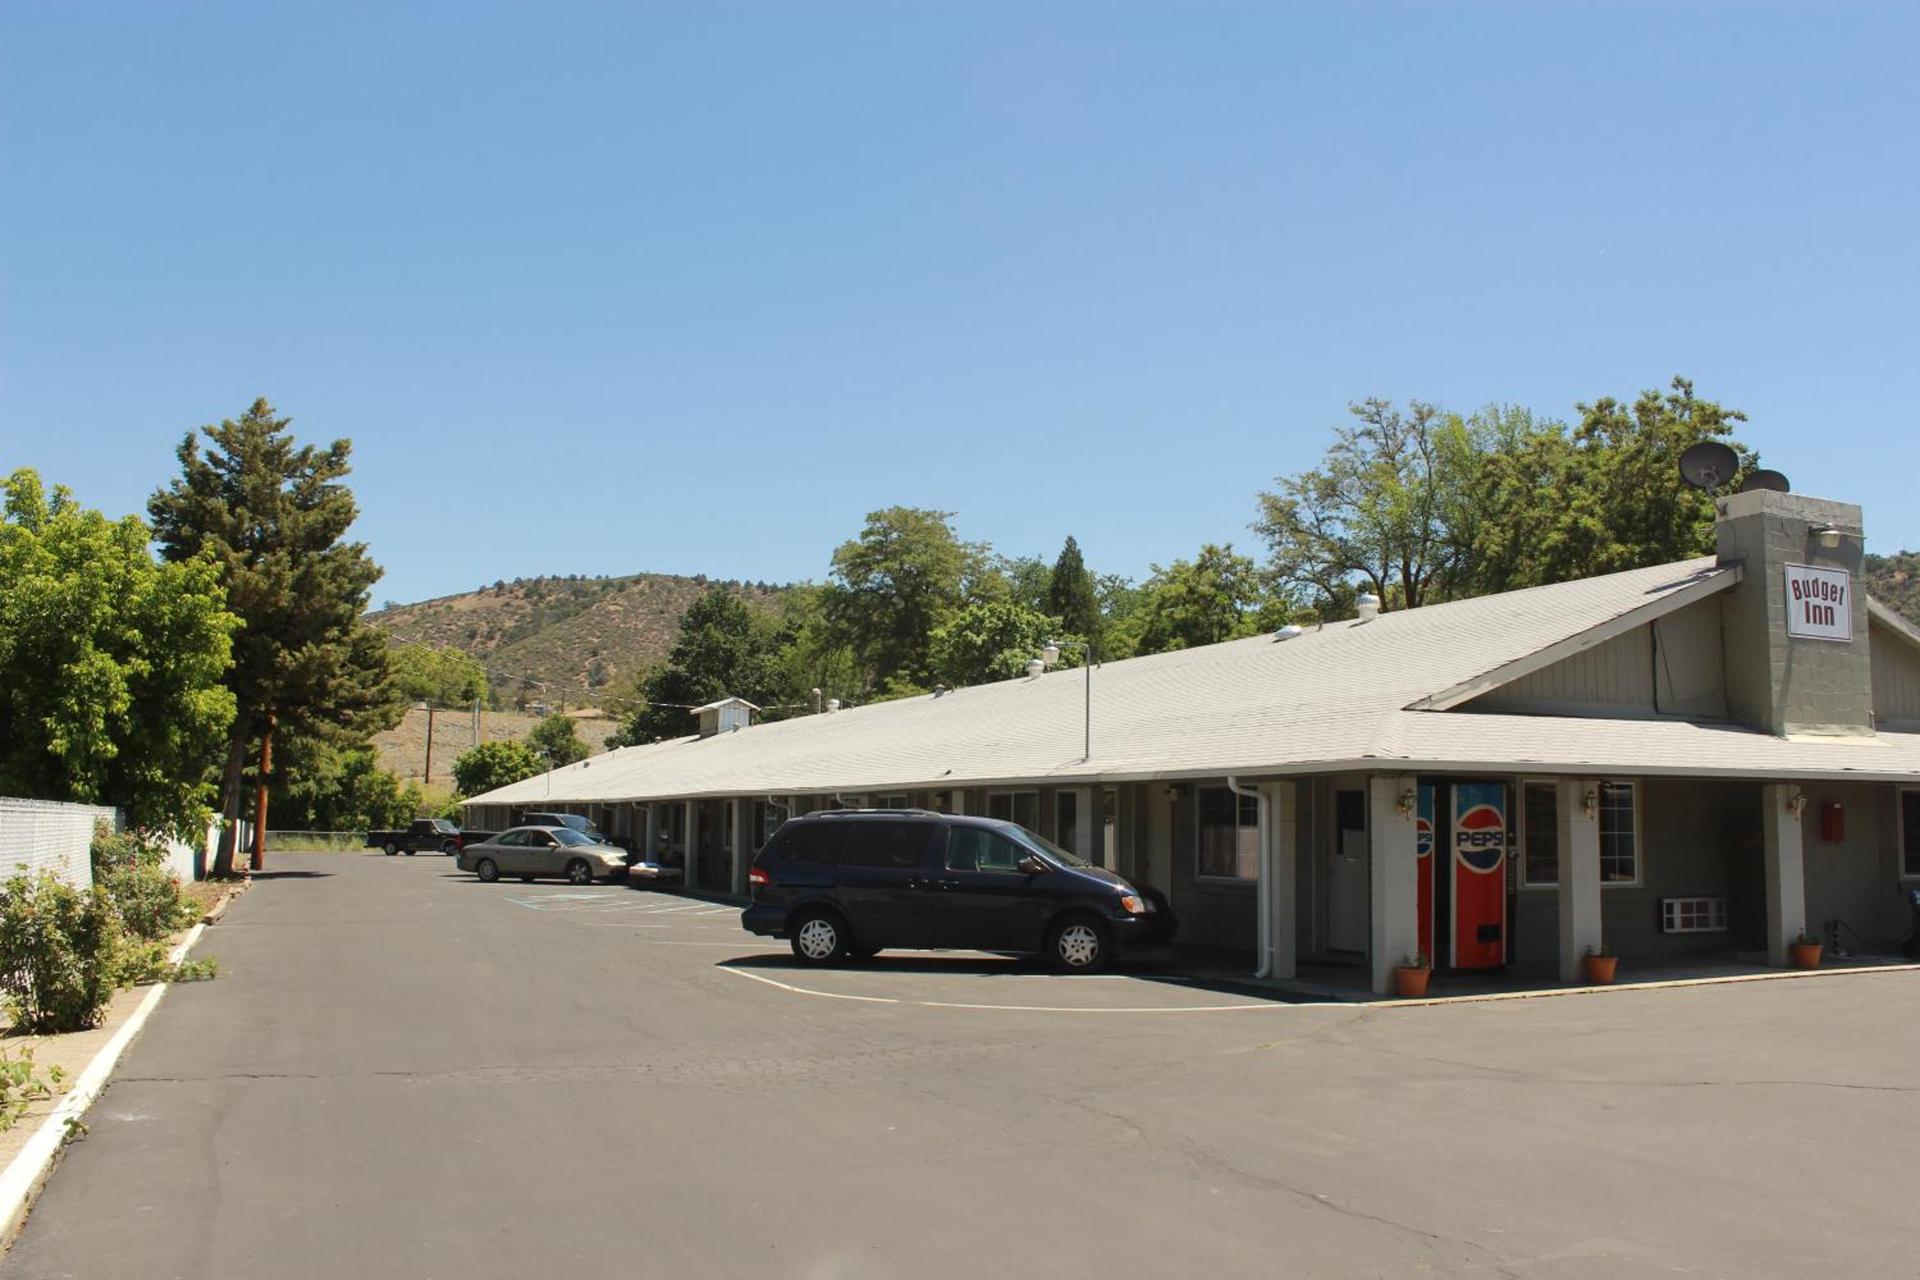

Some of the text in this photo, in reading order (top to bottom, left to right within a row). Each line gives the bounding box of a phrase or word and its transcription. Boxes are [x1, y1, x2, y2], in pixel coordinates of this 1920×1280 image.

[1791, 577, 1845, 605] Budget
[1804, 600, 1835, 626] Inn
[1417, 832, 1433, 842] PSI
[1456, 831, 1504, 847] PEPSI
